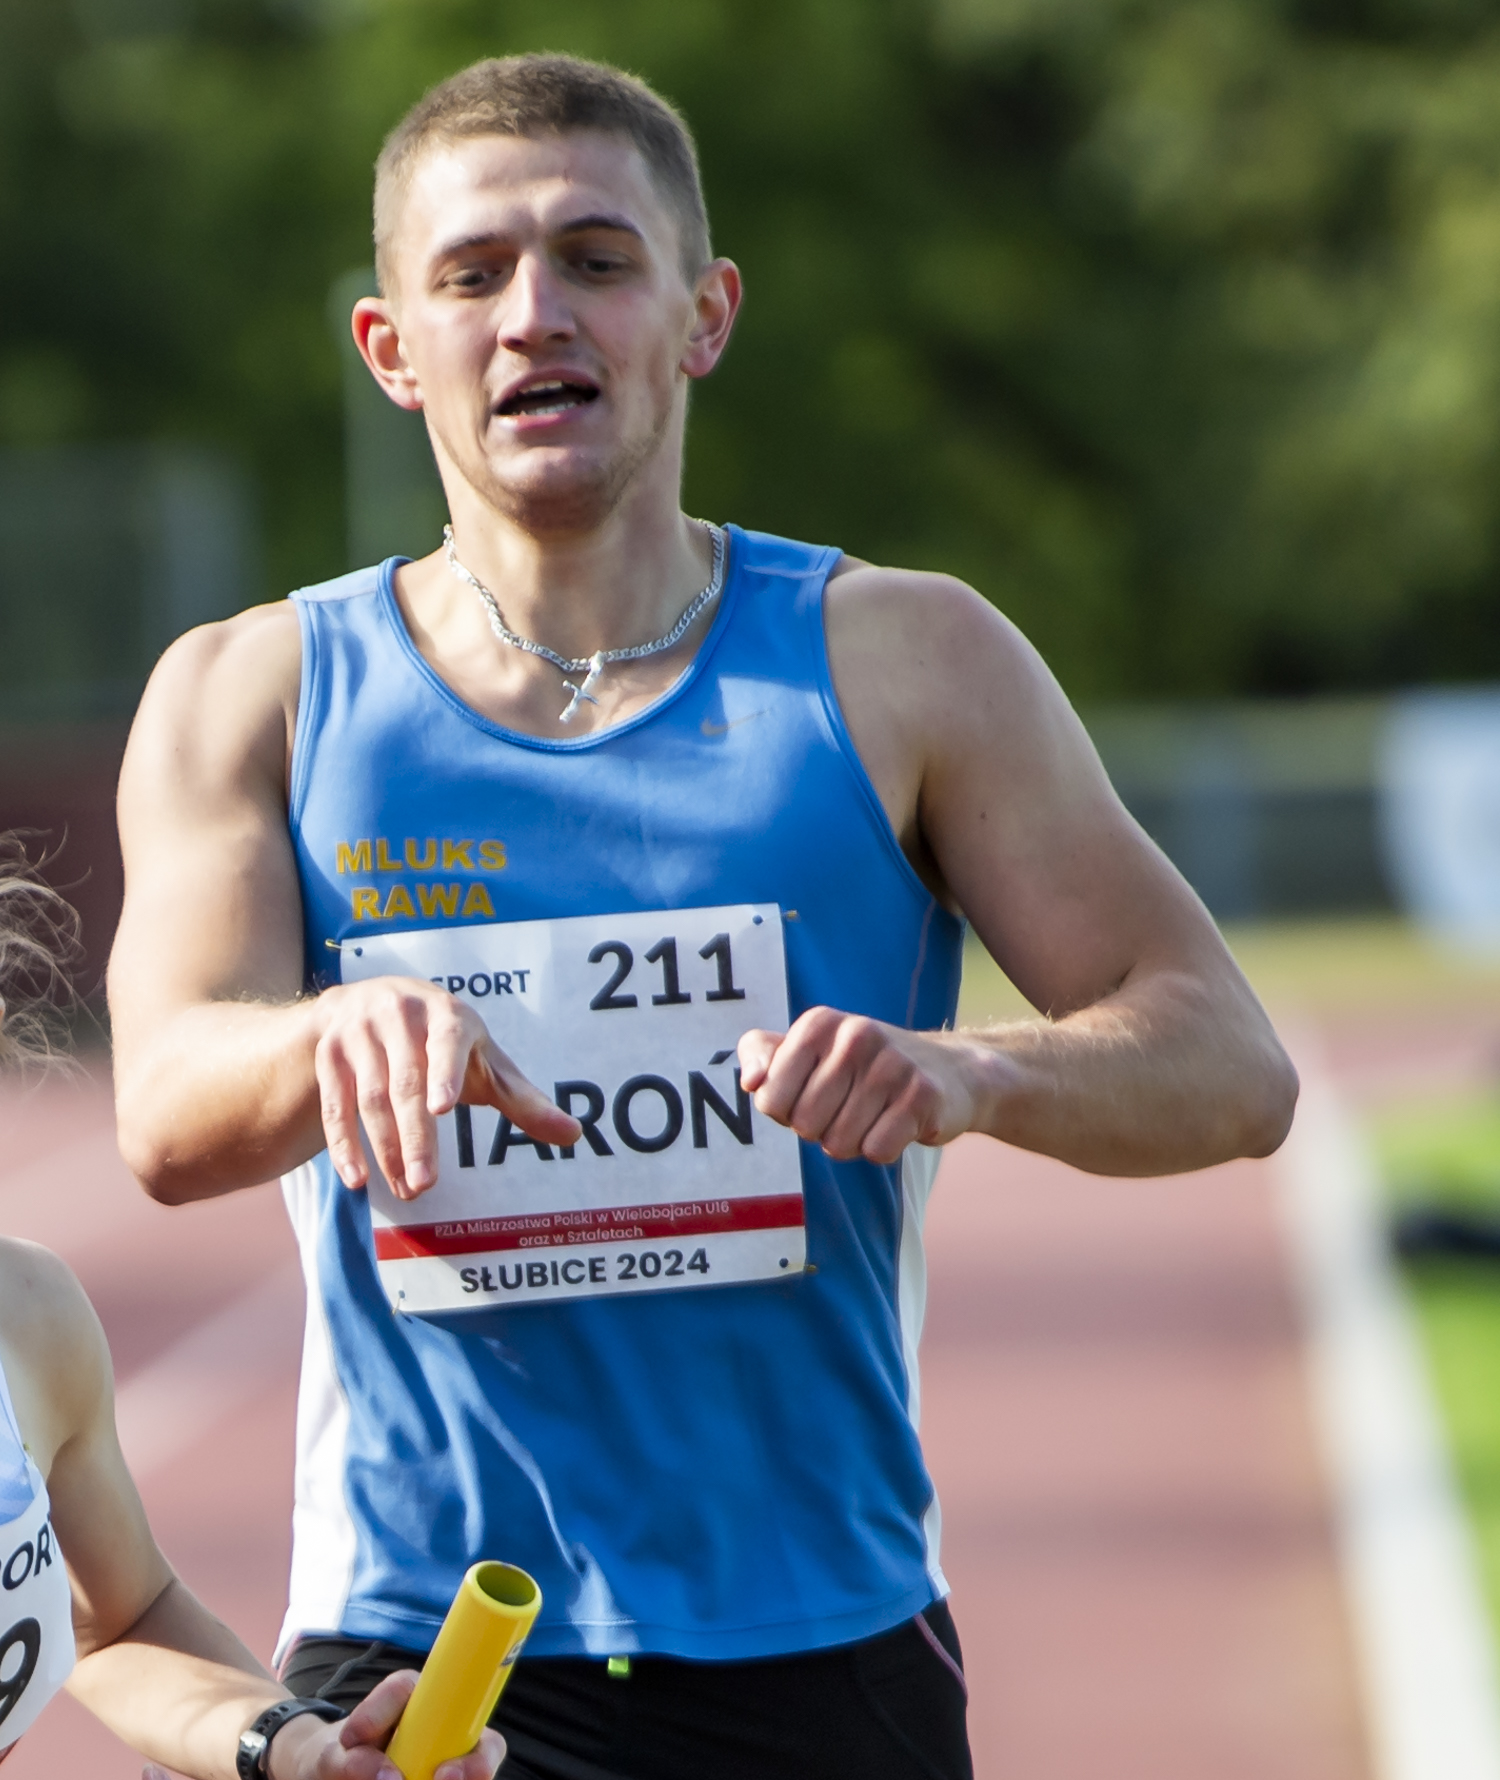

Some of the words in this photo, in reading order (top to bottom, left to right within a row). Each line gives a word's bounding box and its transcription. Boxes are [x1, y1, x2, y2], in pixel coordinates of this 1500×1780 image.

[336, 839, 507, 874] MLUKS
[352, 883, 495, 920] RAWA
[587, 933, 745, 1011] 211
[467, 1217, 551, 1233] Mistrzostwa
[553, 1210, 592, 1226] Polski
[596, 1213, 608, 1223] w
[611, 1203, 702, 1222] Wielobojach
[705, 1201, 730, 1215] U16
[519, 1234, 550, 1247] oraz
[552, 1234, 565, 1244] w
[567, 1225, 643, 1243] Sztafetach
[460, 1257, 607, 1293] SŁUBICE
[616, 1248, 710, 1281] 2024
